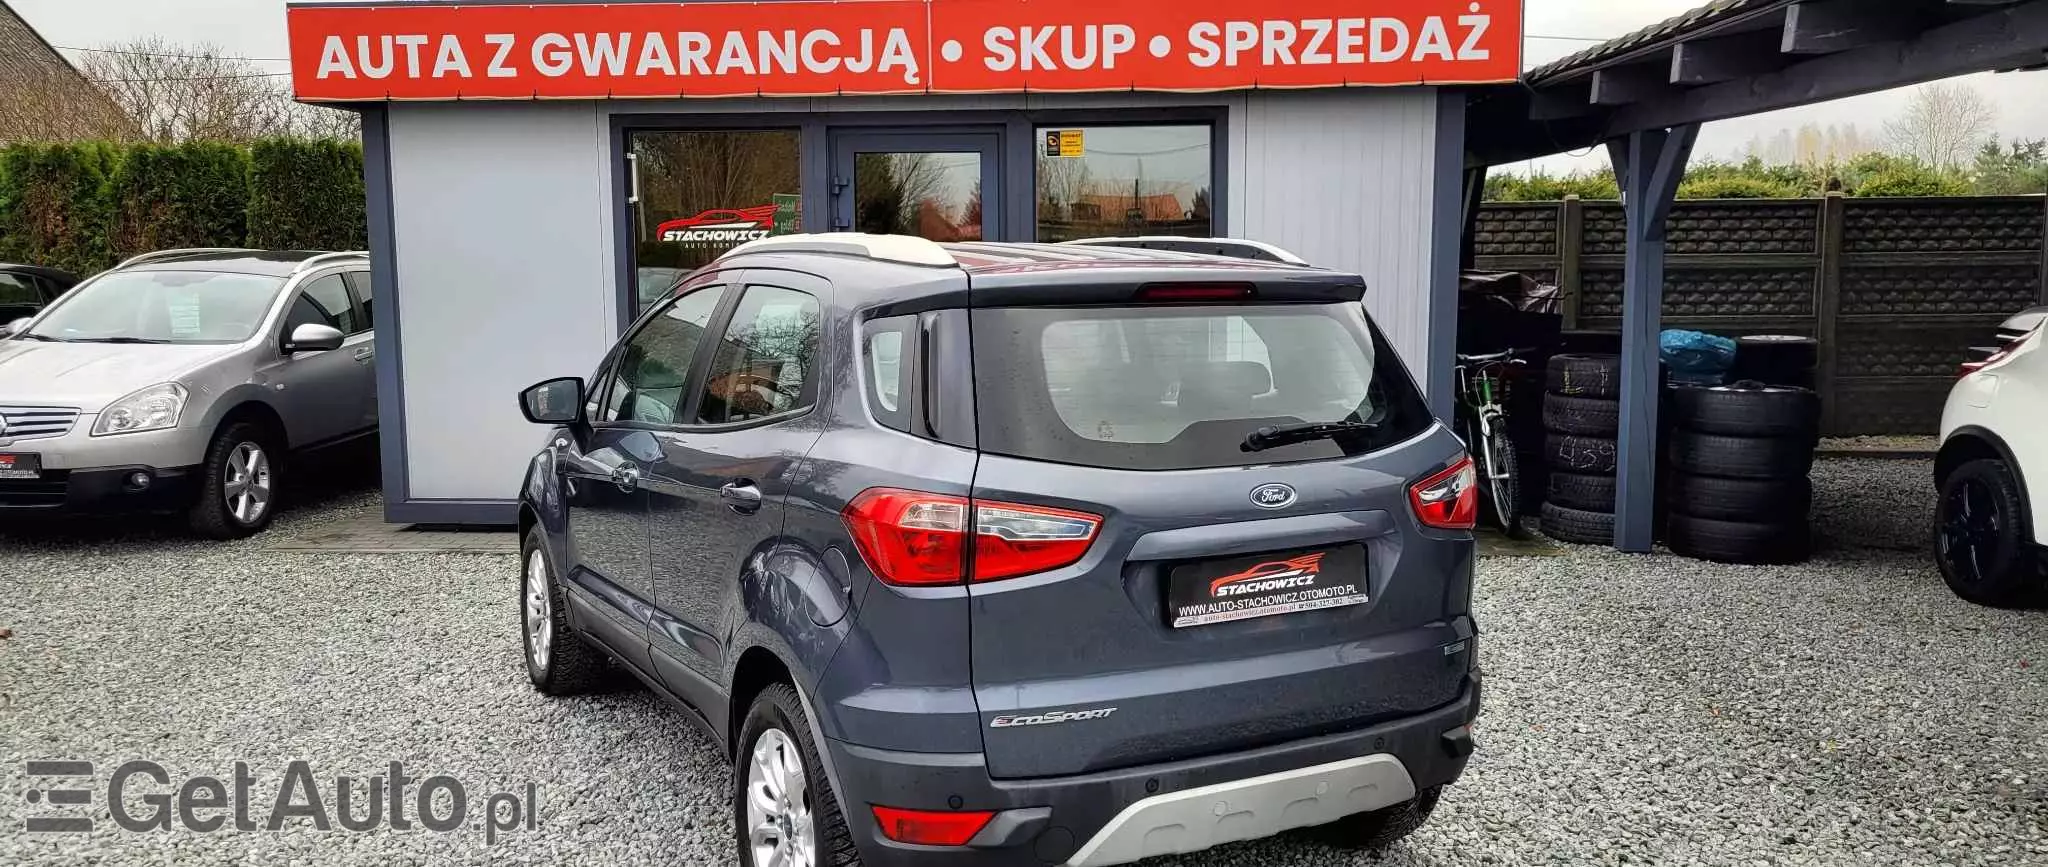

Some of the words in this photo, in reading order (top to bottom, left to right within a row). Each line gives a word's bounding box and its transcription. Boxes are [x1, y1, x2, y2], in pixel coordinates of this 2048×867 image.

[316, 34, 473, 79] AUTA
[485, 33, 517, 77] Z
[532, 28, 921, 84] GWARANCJĄ
[983, 24, 1137, 71] SKUP
[1187, 2, 1491, 66] SPRZEDAŻ
[663, 230, 770, 241] STACHOWICZ
[1260, 487, 1286, 502] Ford
[1216, 575, 1316, 597] STACHOWICZ
[1179, 584, 1358, 616] WWW.AUTO-STACHOWICZ.OTOMOTO.PL
